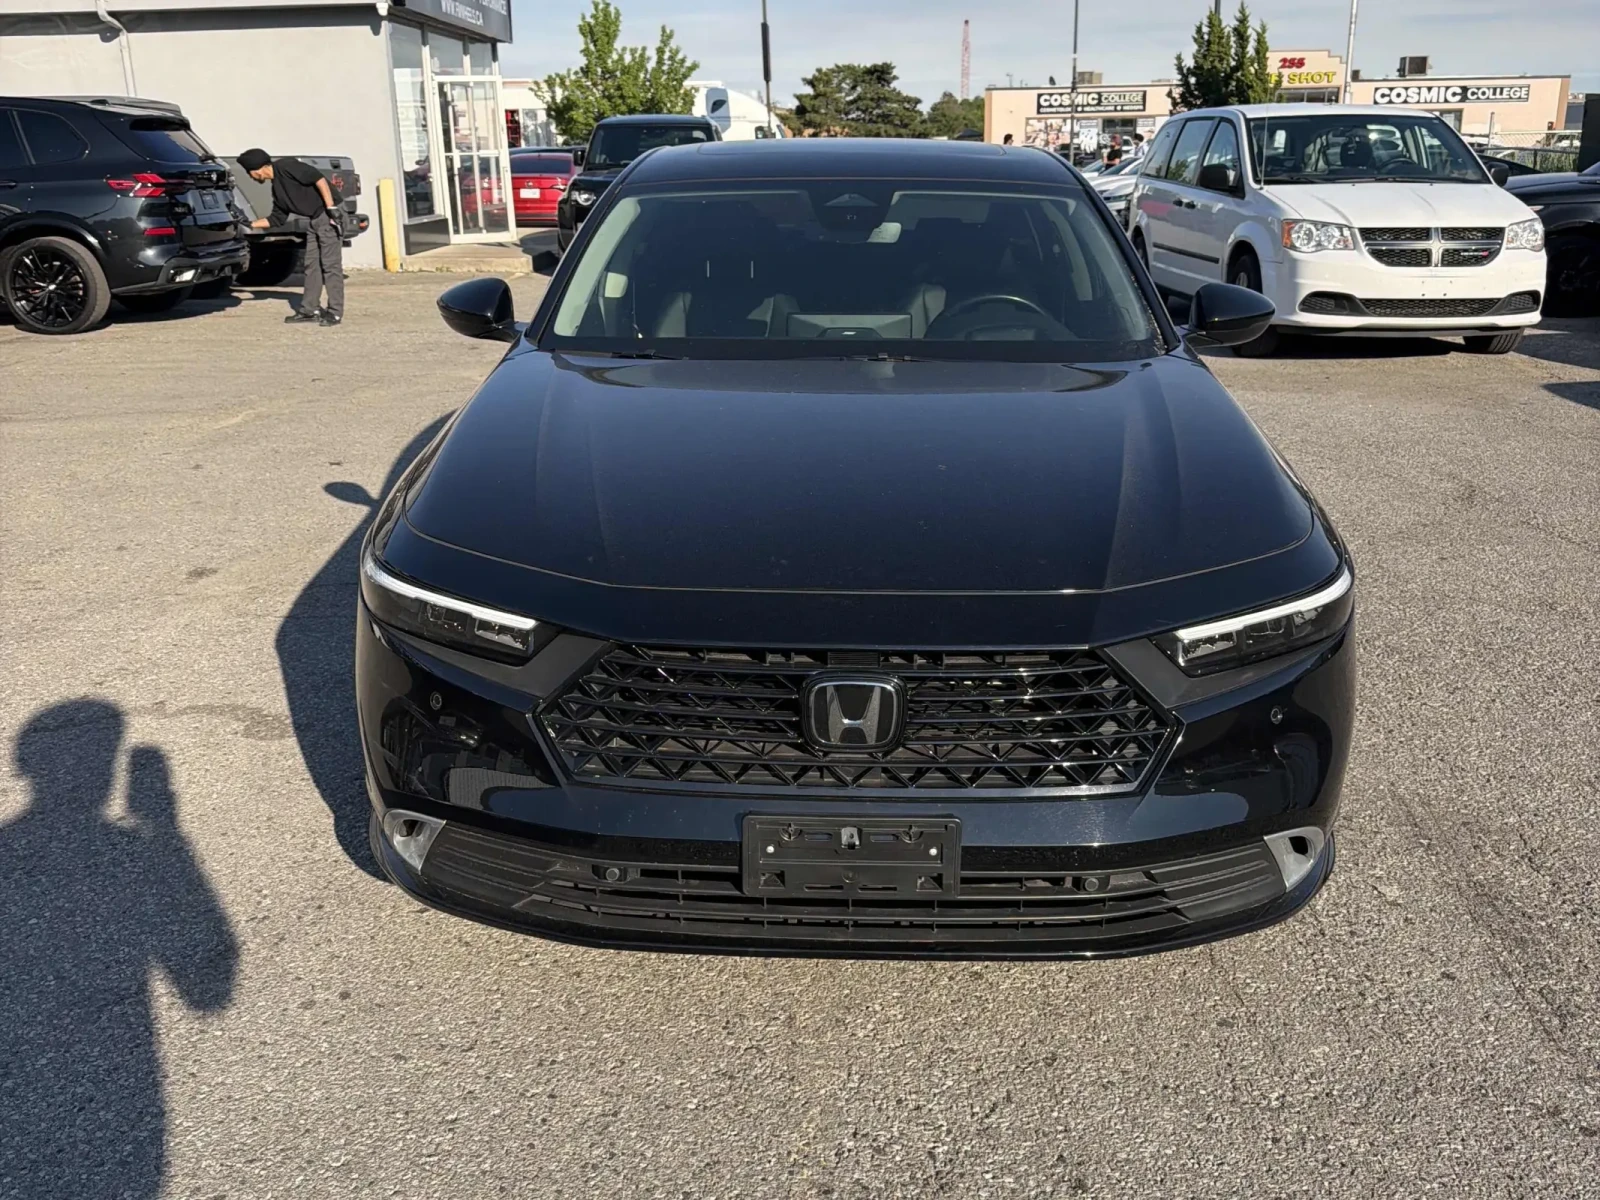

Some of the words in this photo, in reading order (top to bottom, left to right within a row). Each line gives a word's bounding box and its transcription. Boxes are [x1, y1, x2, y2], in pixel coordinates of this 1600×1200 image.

[1279, 57, 1306, 69] 255
[1287, 71, 1336, 84] SHOT
[1040, 93, 1098, 106] COSMIC
[1101, 93, 1144, 103] COLLEGE
[1374, 87, 1462, 104] COSMIC
[1467, 87, 1529, 99] COLLEGE
